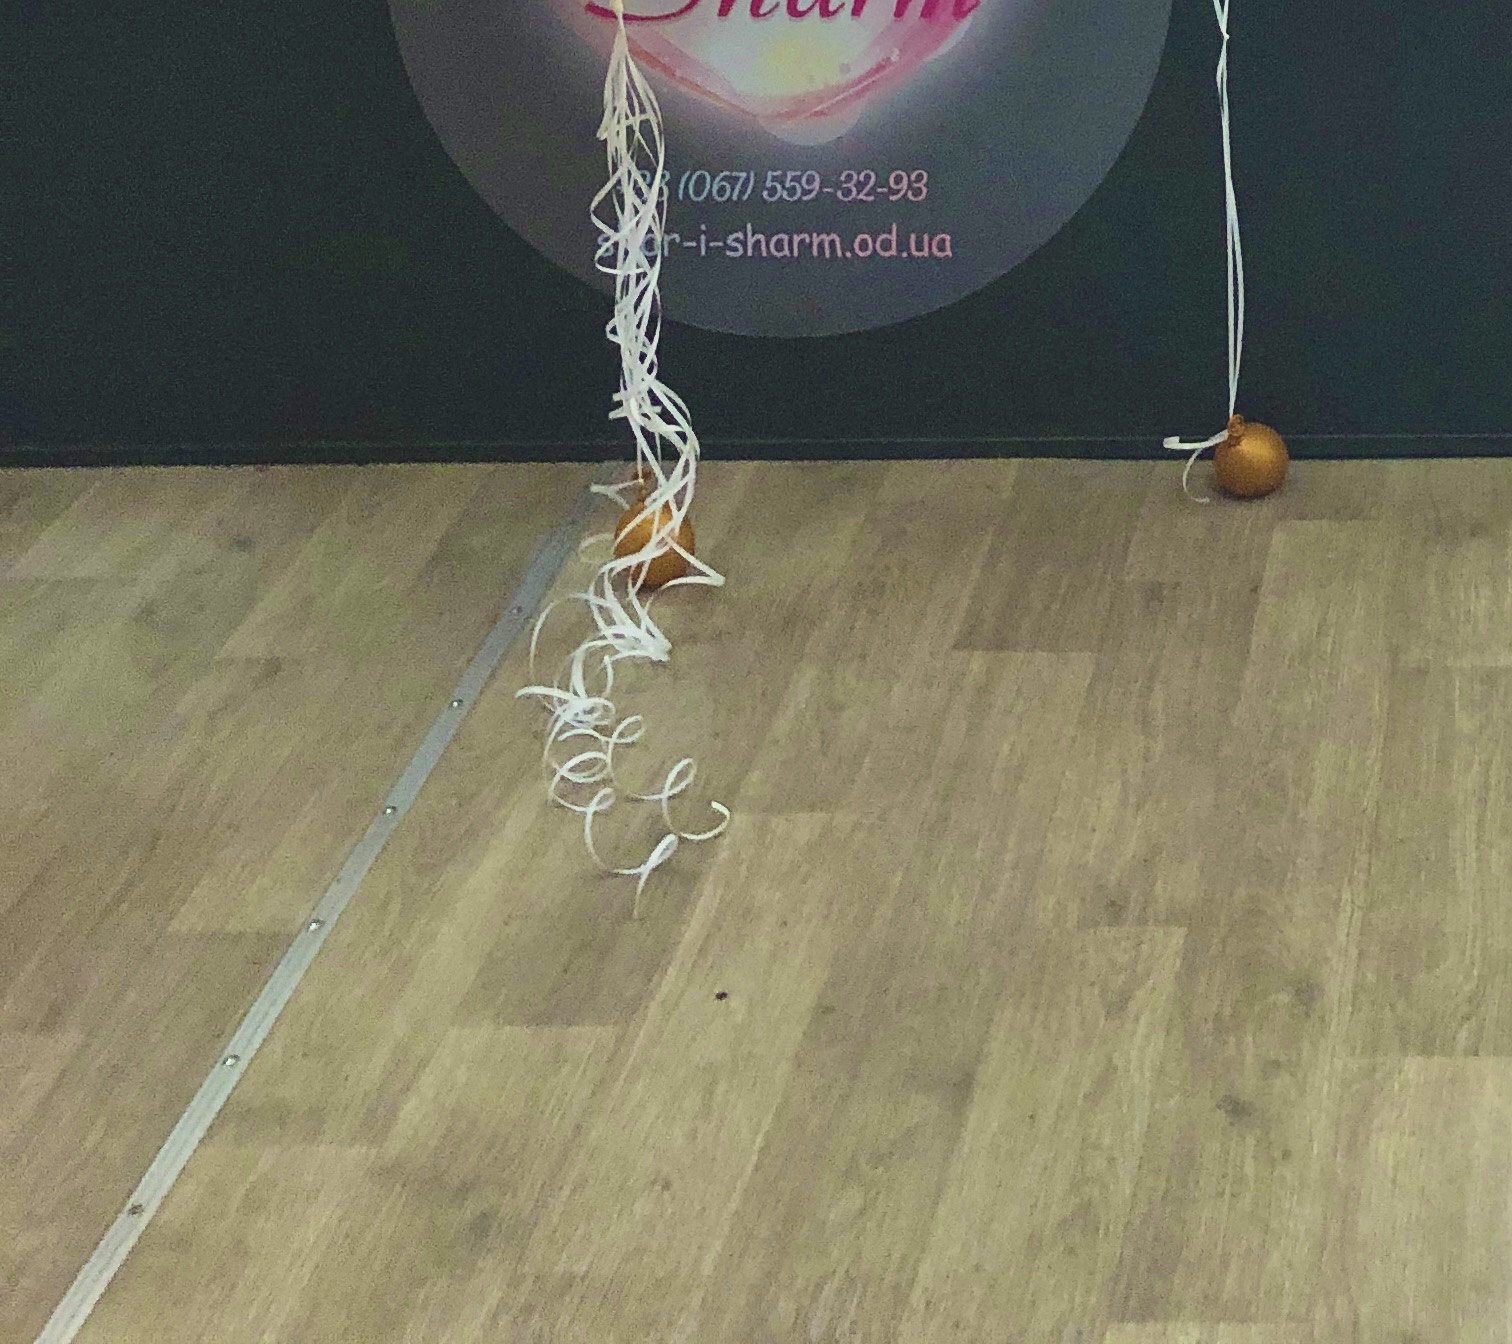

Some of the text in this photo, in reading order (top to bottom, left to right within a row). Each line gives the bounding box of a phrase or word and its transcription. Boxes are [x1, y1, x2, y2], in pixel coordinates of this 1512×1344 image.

[677, 169, 755, 203] (067)
[761, 169, 930, 203] 559-32-93
[596, 222, 954, 259] sar-i-sharm.od.ua
